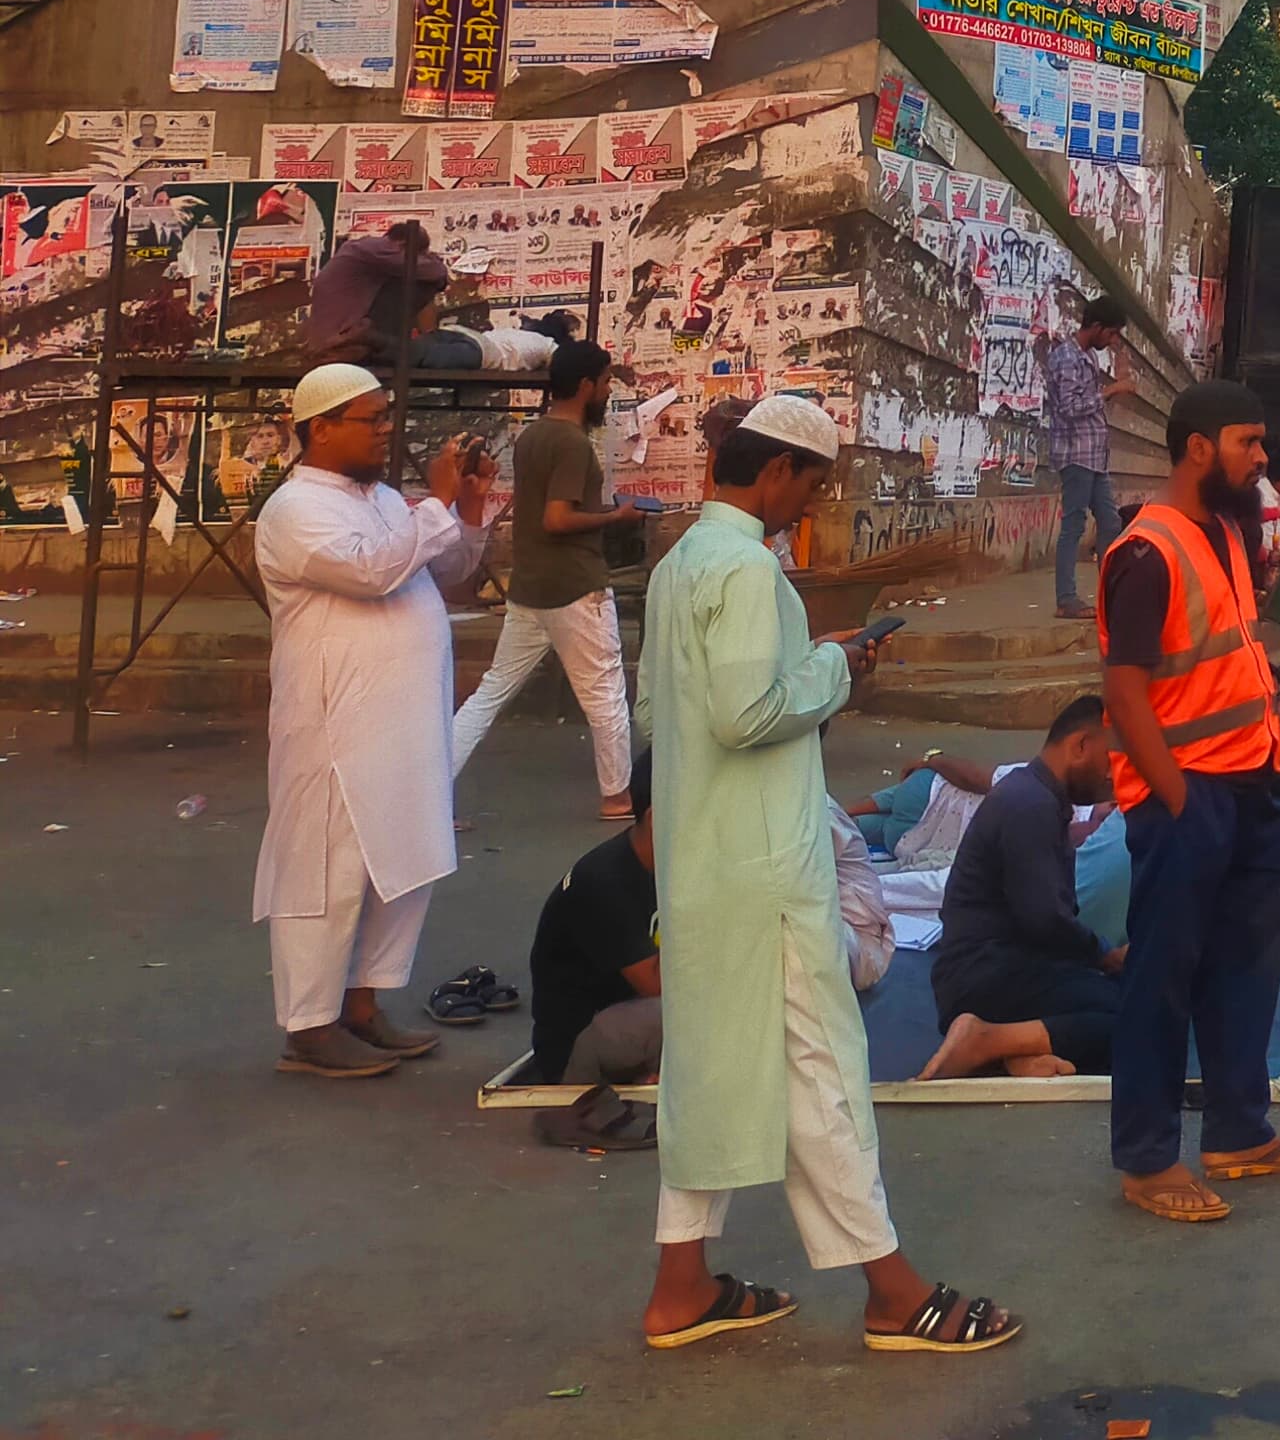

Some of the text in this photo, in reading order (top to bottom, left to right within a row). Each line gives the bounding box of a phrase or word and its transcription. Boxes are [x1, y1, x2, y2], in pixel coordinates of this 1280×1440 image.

[929, 12, 1091, 57] 01776-446627, 01703-139804
[1110, 18, 1152, 51] জীবন
